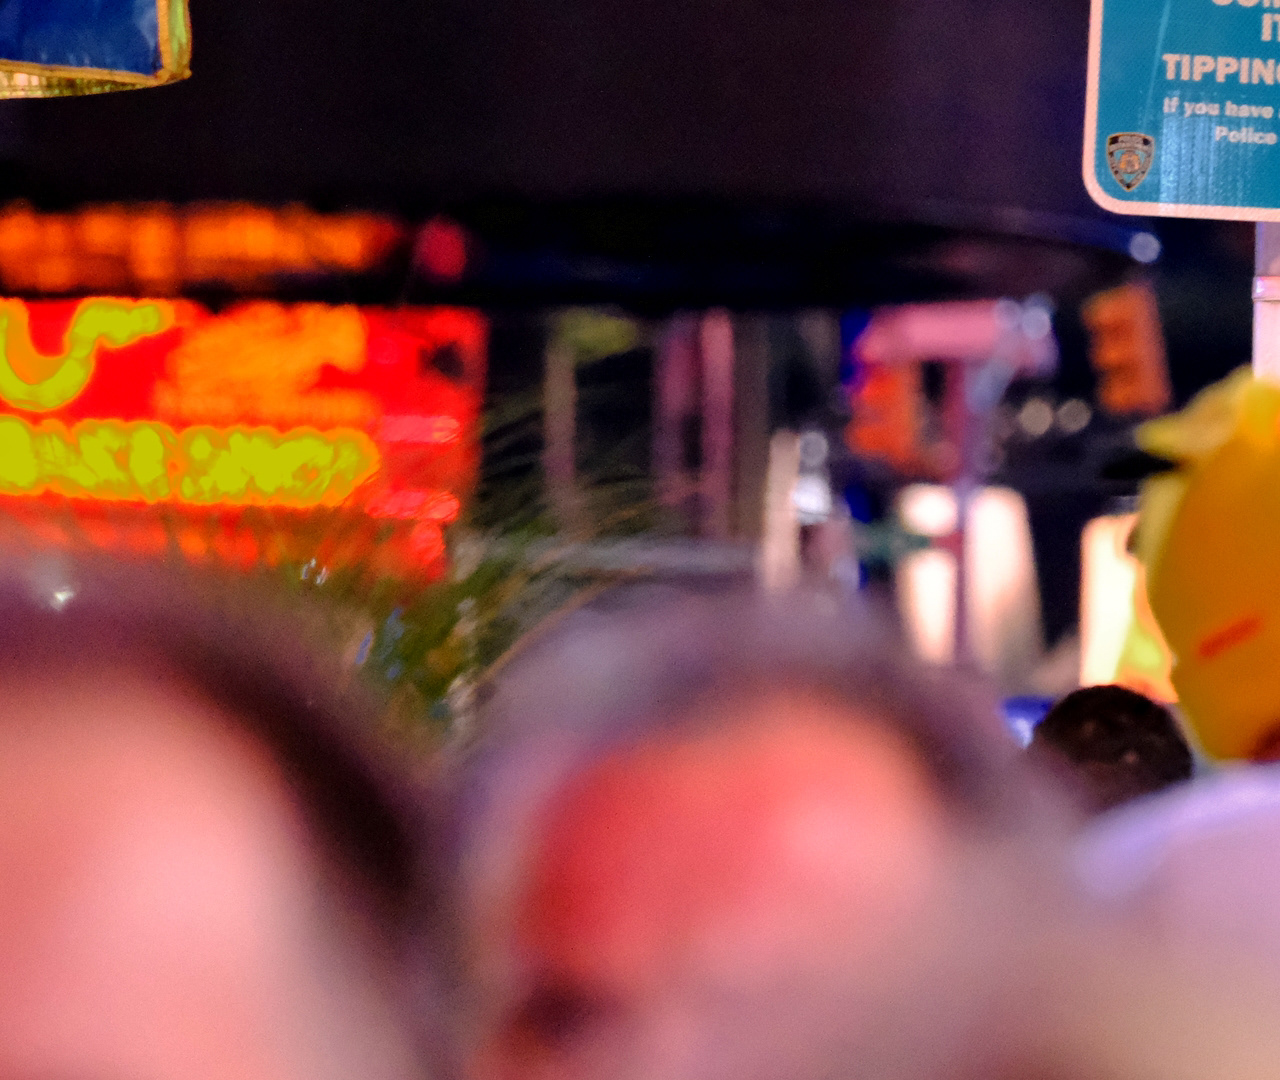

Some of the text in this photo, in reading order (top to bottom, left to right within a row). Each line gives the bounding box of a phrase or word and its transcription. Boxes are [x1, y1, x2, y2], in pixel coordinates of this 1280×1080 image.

[1163, 97, 1179, 113] If
[1184, 102, 1220, 118] you
[1225, 101, 1273, 119] have
[1215, 125, 1276, 145] Police
